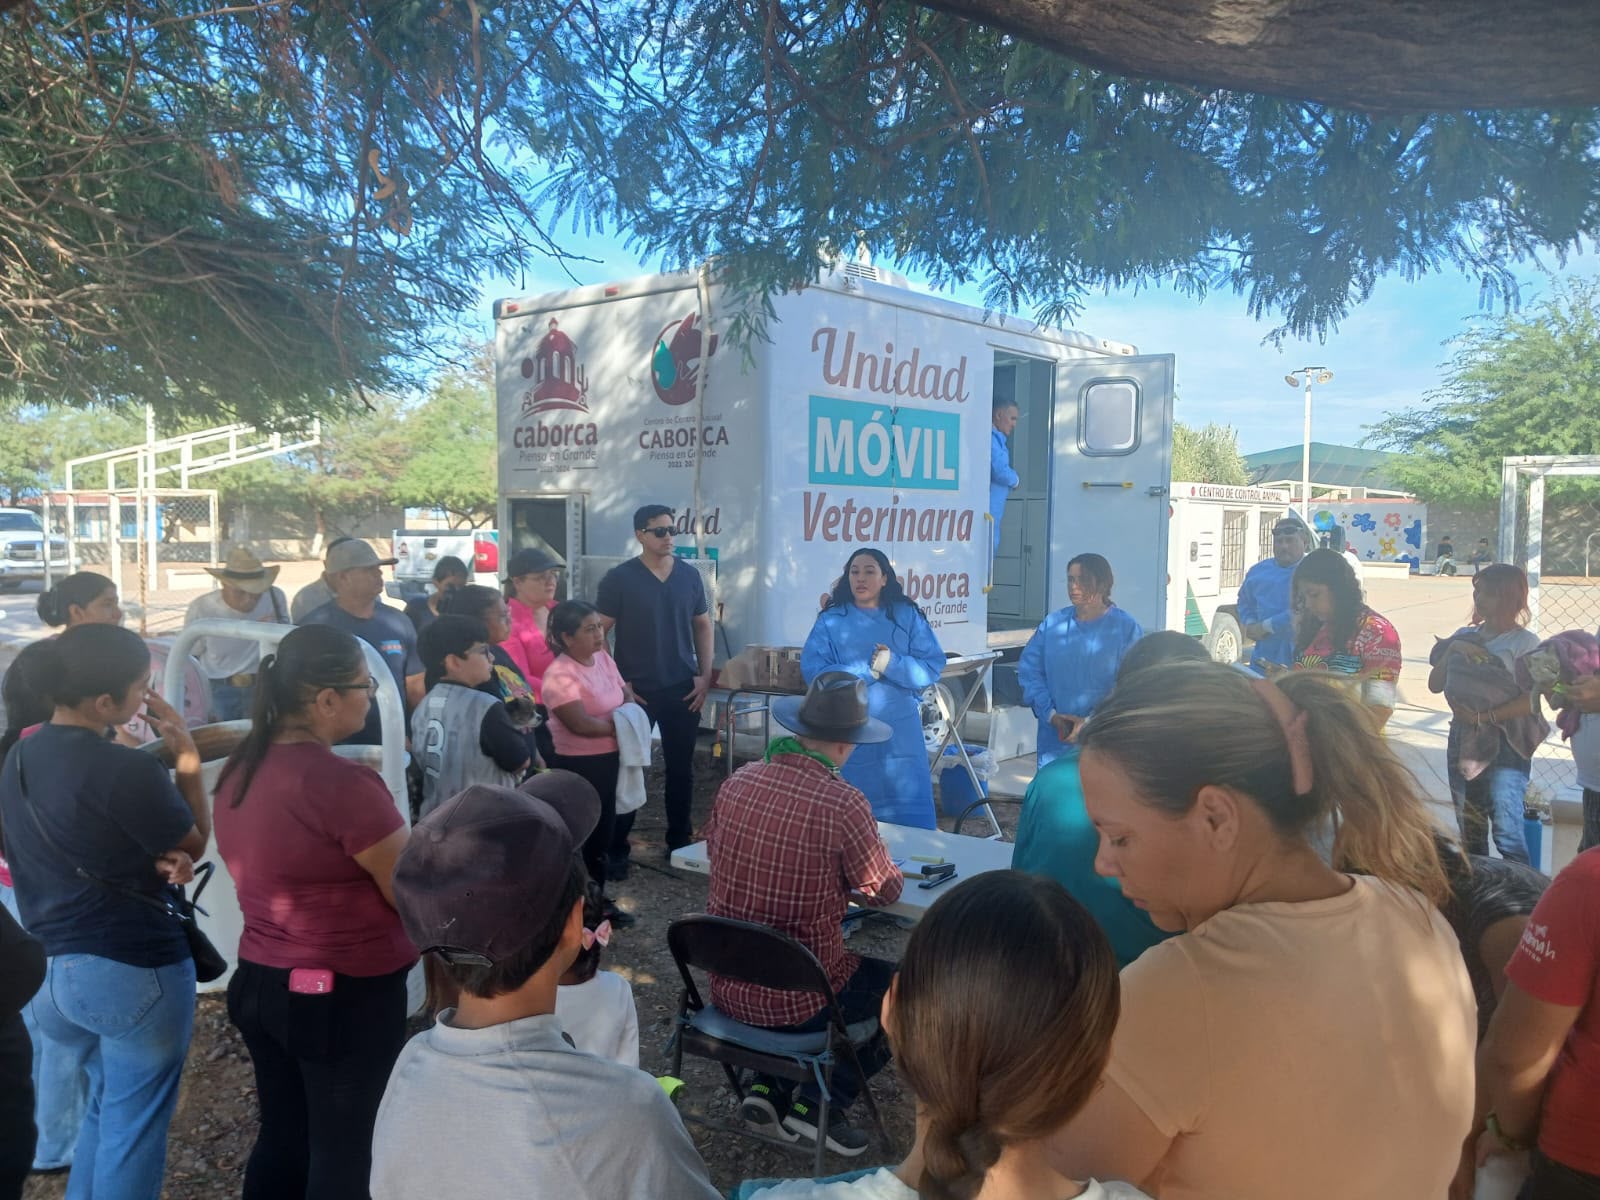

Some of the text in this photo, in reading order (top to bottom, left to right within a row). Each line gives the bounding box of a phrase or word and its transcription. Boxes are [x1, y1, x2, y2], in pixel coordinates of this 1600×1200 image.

[811, 327, 970, 403] Unidad
[513, 420, 598, 449] caborca
[814, 410, 956, 480] MÓVIL
[562, 447, 597, 461] Grande
[1199, 486, 1225, 499] CENTRO
[1226, 488, 1234, 499] DE
[802, 491, 974, 542] Veterinaria
[934, 600, 968, 615] Grande
